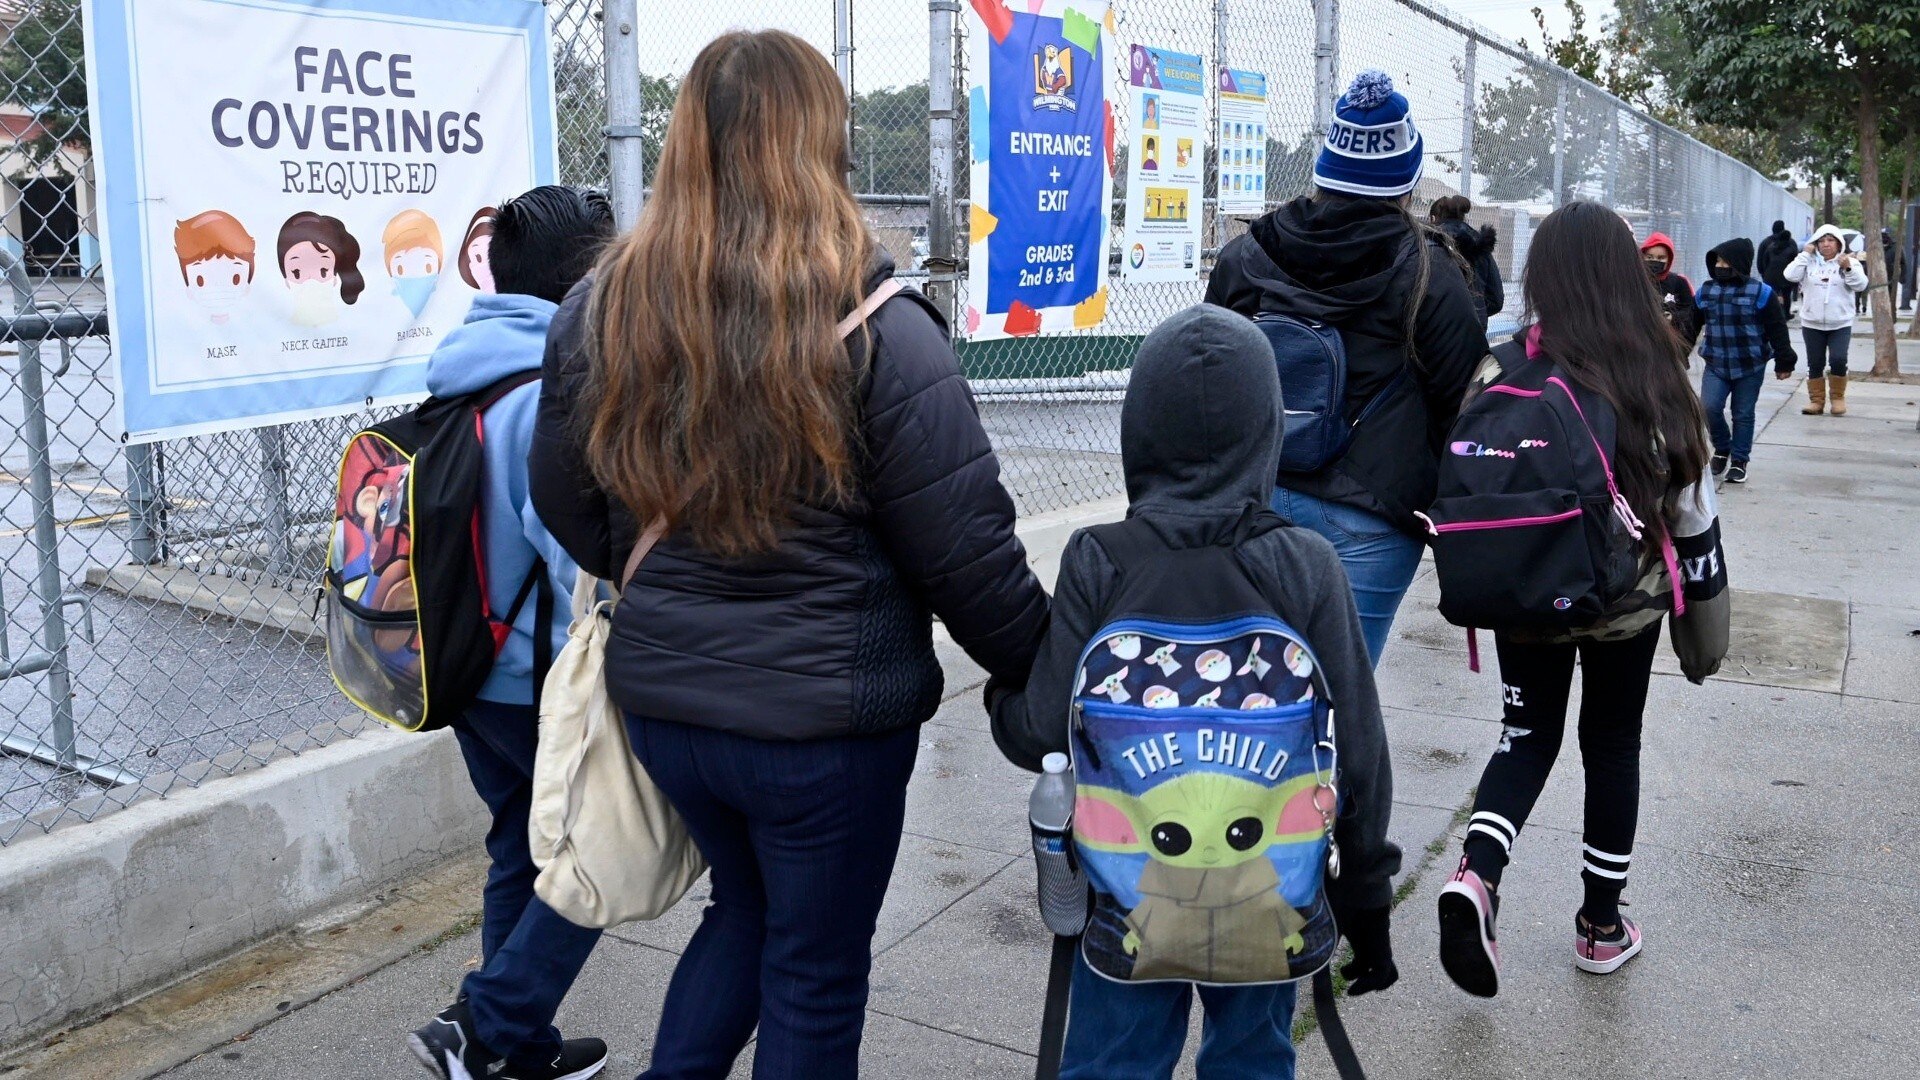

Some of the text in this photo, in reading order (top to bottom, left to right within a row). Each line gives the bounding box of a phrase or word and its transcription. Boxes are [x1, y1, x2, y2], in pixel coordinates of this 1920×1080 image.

[294, 46, 416, 99] FACE
[1163, 67, 1202, 83] WELCOME
[1032, 95, 1077, 112] WILMINGTON
[211, 97, 484, 155] COVERINGS
[1010, 131, 1092, 157] ENTRANCE
[1327, 122, 1396, 154] DGERS
[279, 160, 437, 201] REQUIRED
[1038, 190, 1069, 212] EXIT
[1025, 244, 1074, 264] GRADES
[1018, 262, 1075, 287] 2nd & 3rd
[206, 345, 238, 359] MASK
[280, 336, 349, 352] NECK GAITER
[1450, 438, 1549, 459] Chamon
[1121, 727, 1290, 782] THE CHILD
